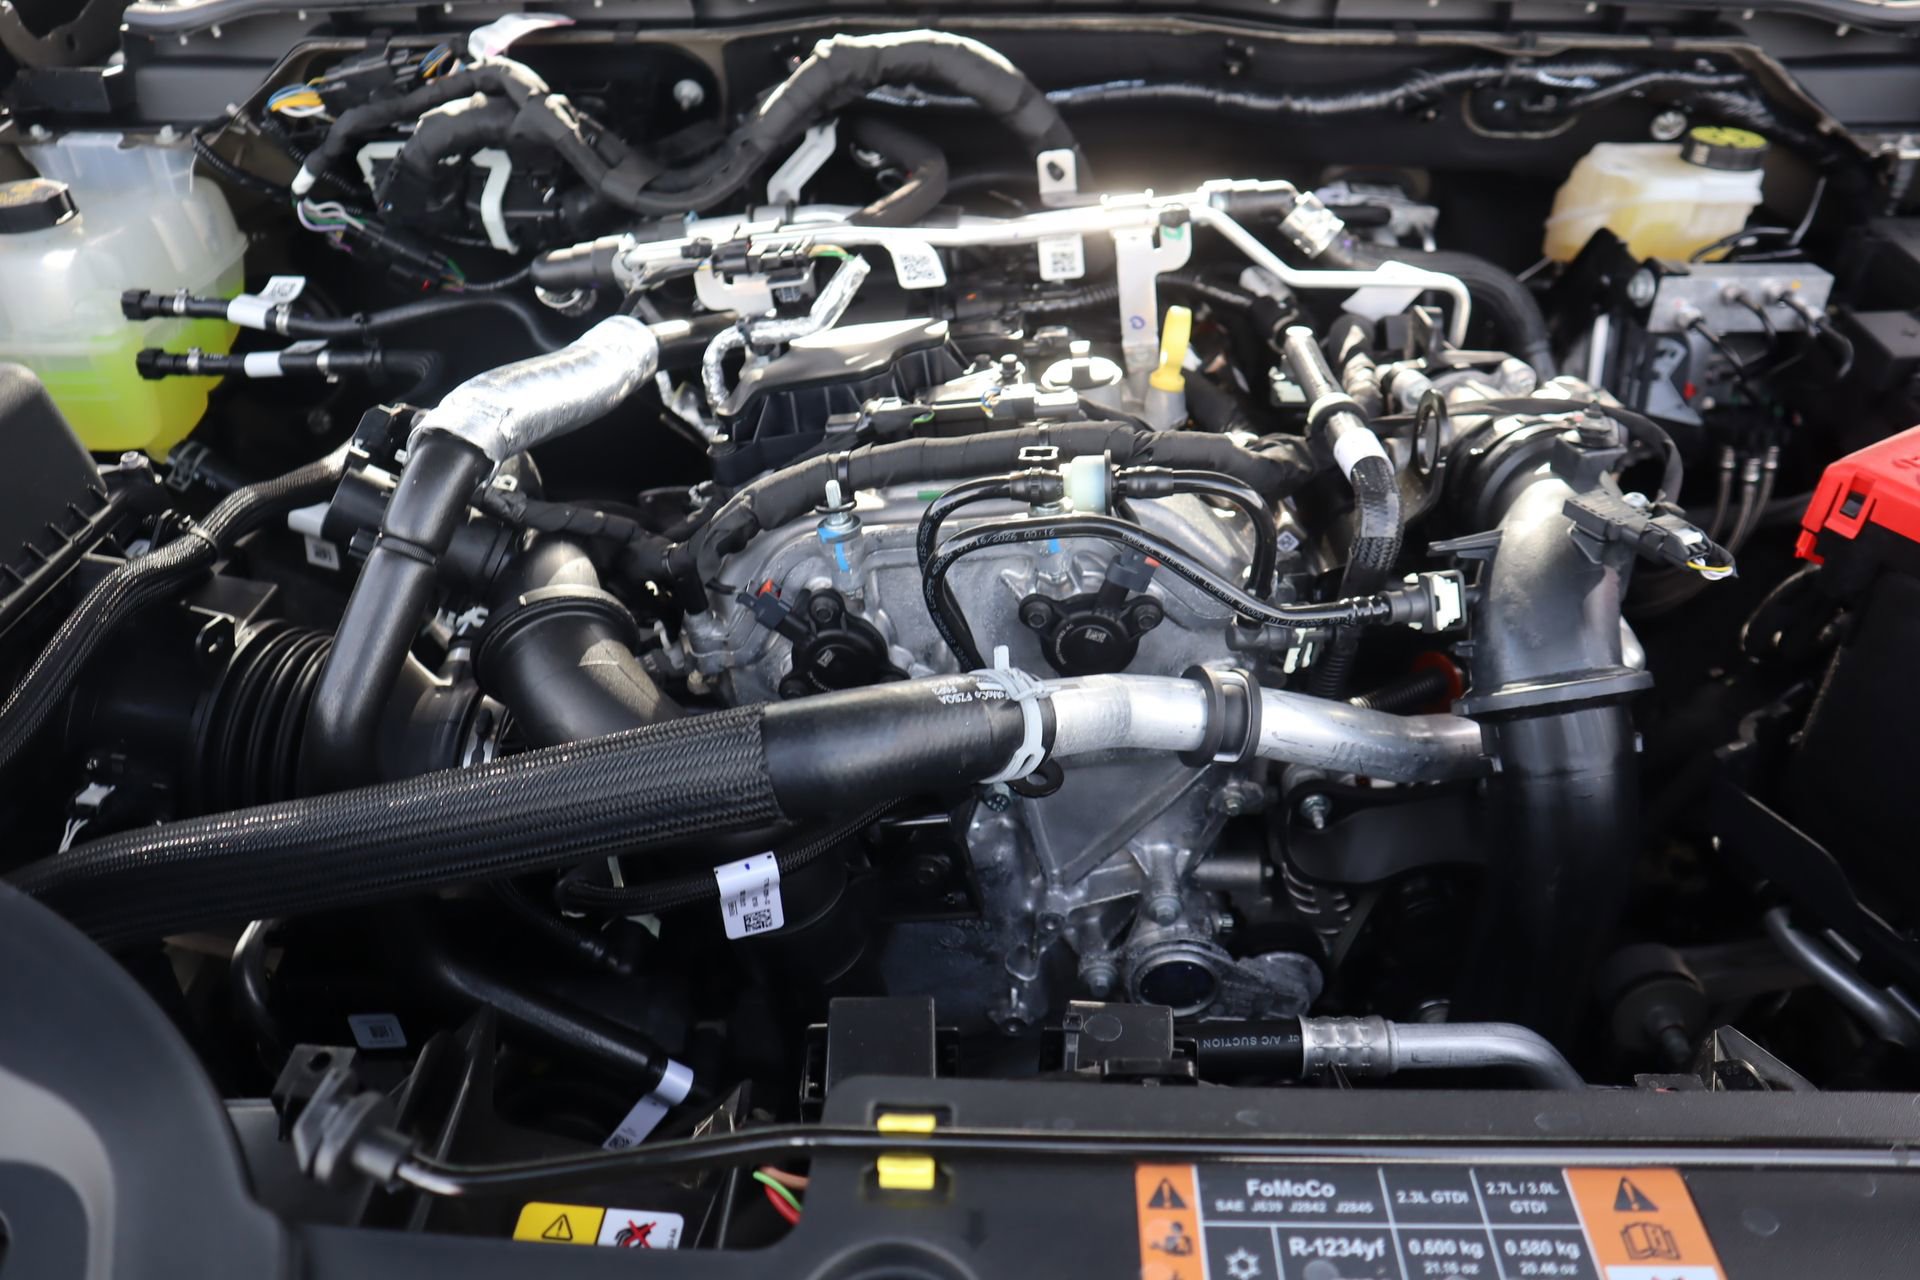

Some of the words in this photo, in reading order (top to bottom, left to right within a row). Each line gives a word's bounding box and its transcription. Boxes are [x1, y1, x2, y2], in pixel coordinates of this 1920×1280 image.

[1203, 1036, 1257, 1049] SUCTION
[1261, 1035, 1281, 1046] A/C
[1246, 1178, 1336, 1198] FoMoCo
[1485, 1182, 1518, 1195] 2.7L
[1396, 1190, 1429, 1204] 2.3L
[1431, 1190, 1470, 1204] GTDI
[1214, 1199, 1246, 1213] SAE
[1509, 1201, 1548, 1214] GTDI
[1288, 1236, 1386, 1261] R-1234yf
[1459, 1240, 1485, 1260] kg
[1555, 1240, 1581, 1260] kg
[1461, 1264, 1481, 1275] oz
[1559, 1264, 1579, 1276] oz
